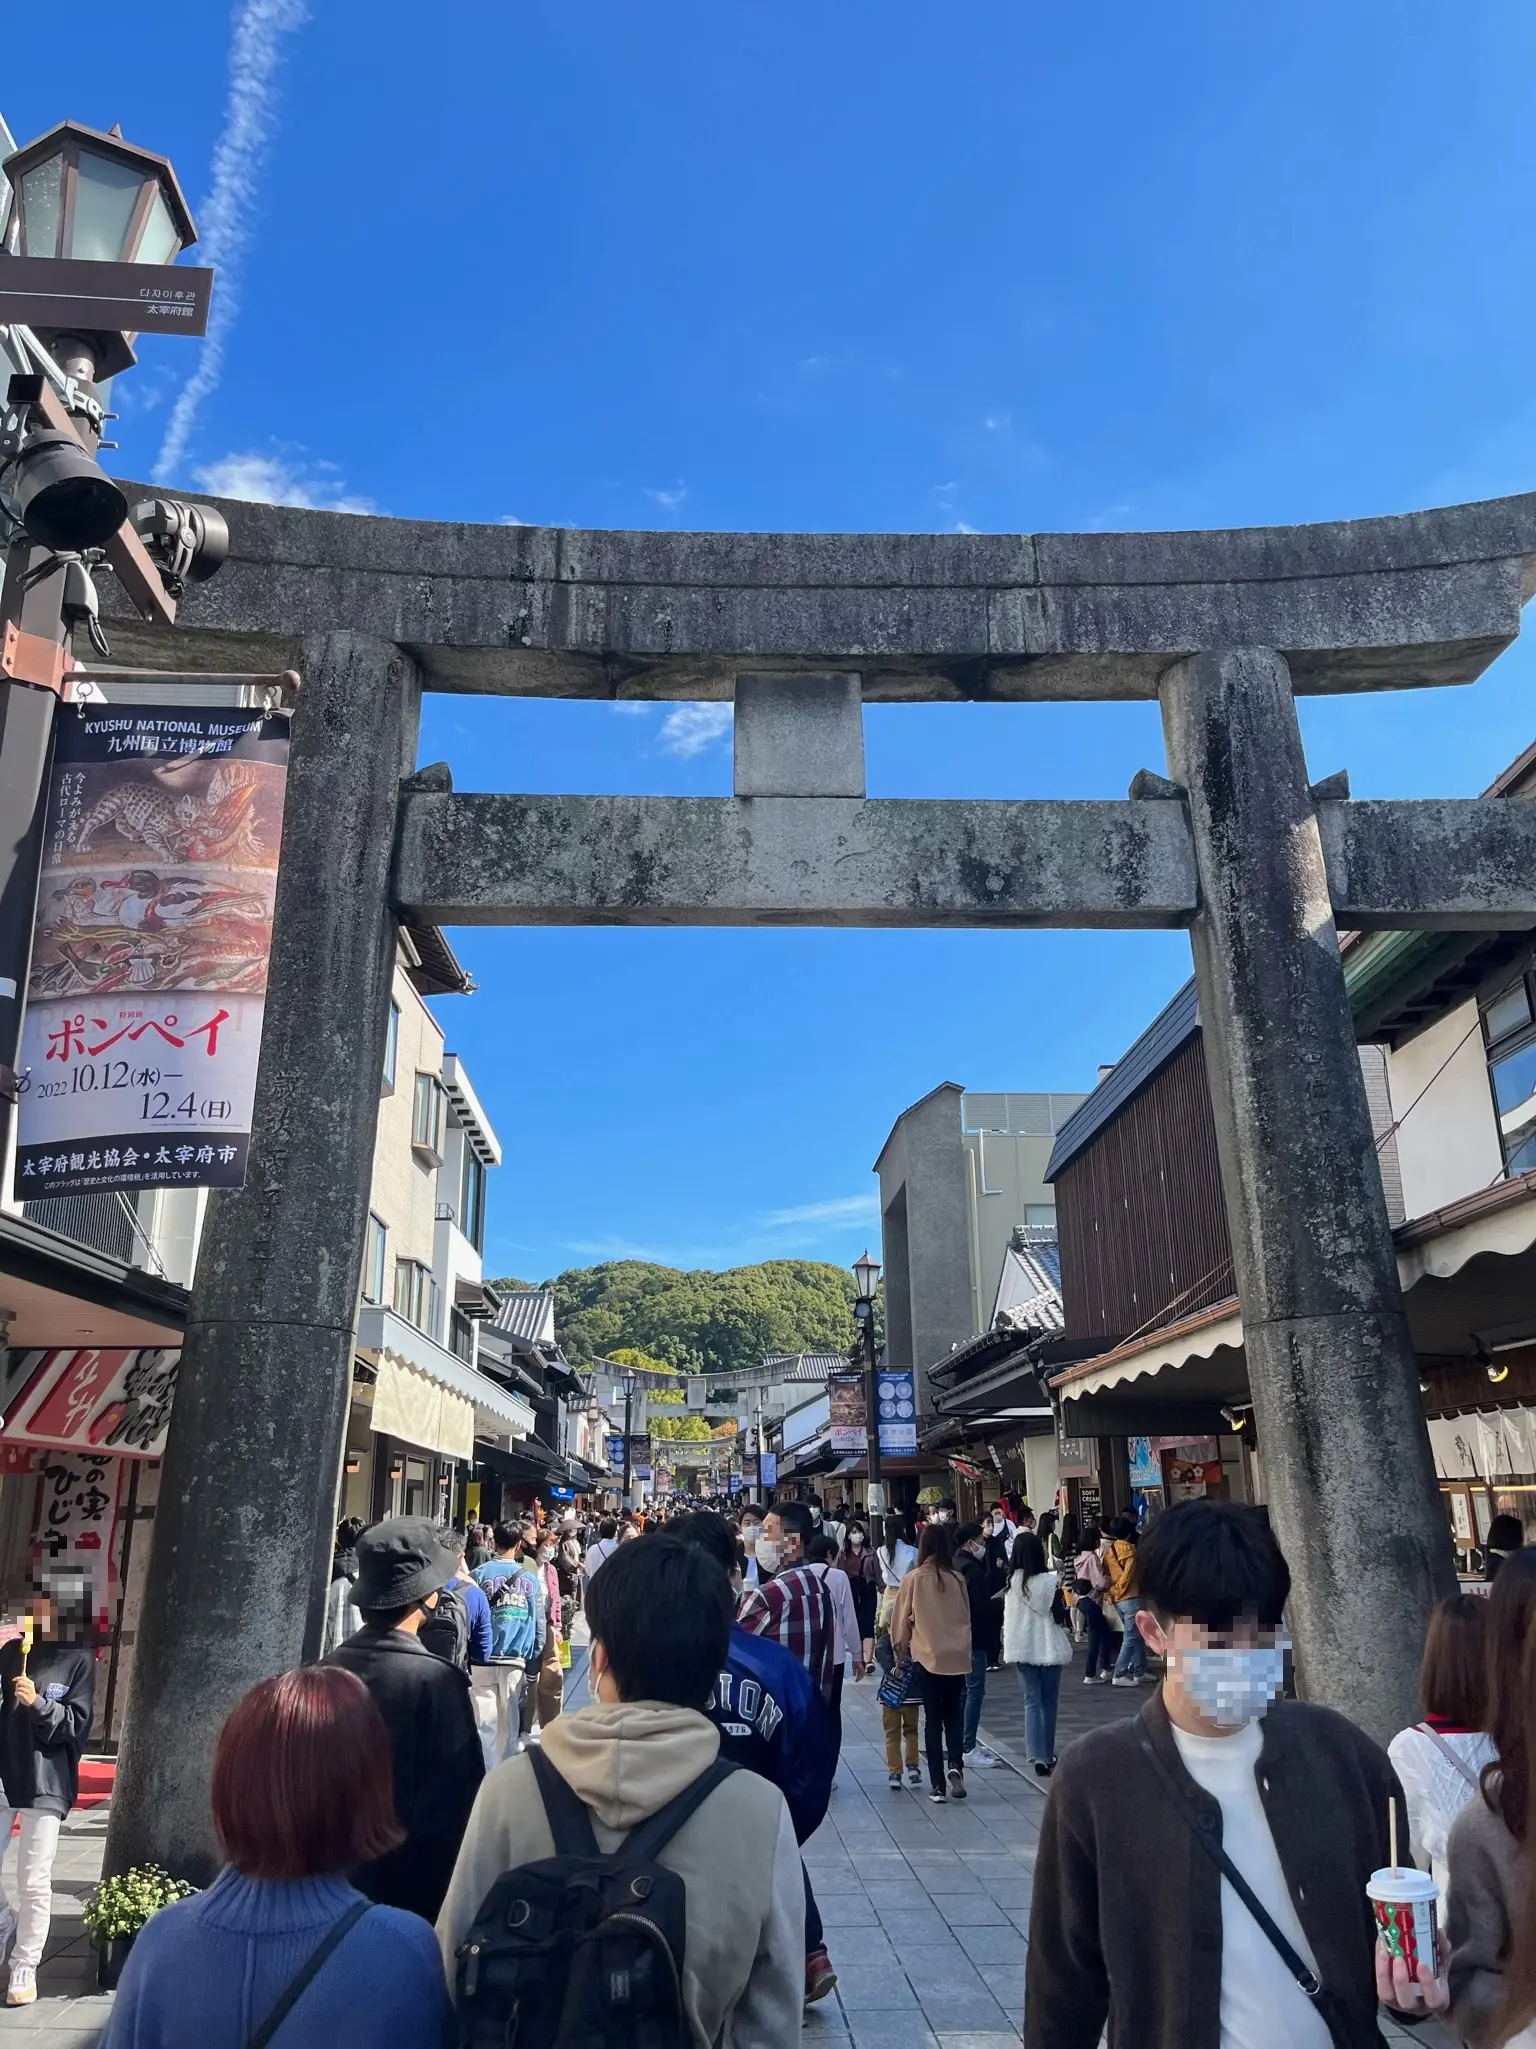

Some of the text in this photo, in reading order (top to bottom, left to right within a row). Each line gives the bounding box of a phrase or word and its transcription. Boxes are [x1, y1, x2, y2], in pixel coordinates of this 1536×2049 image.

[139, 288, 196, 301] 다자이후관
[147, 304, 194, 317] 太宰府館
[85, 719, 262, 736] KYUSHU NATIONAL MUSEUM
[107, 735, 235, 754] 九州国立博物館
[46, 1008, 231, 1062] ポンペイ
[37, 1082, 67, 1099] 2022
[497, 1593, 527, 1608] LACE
[705, 1673, 783, 1742] ION
